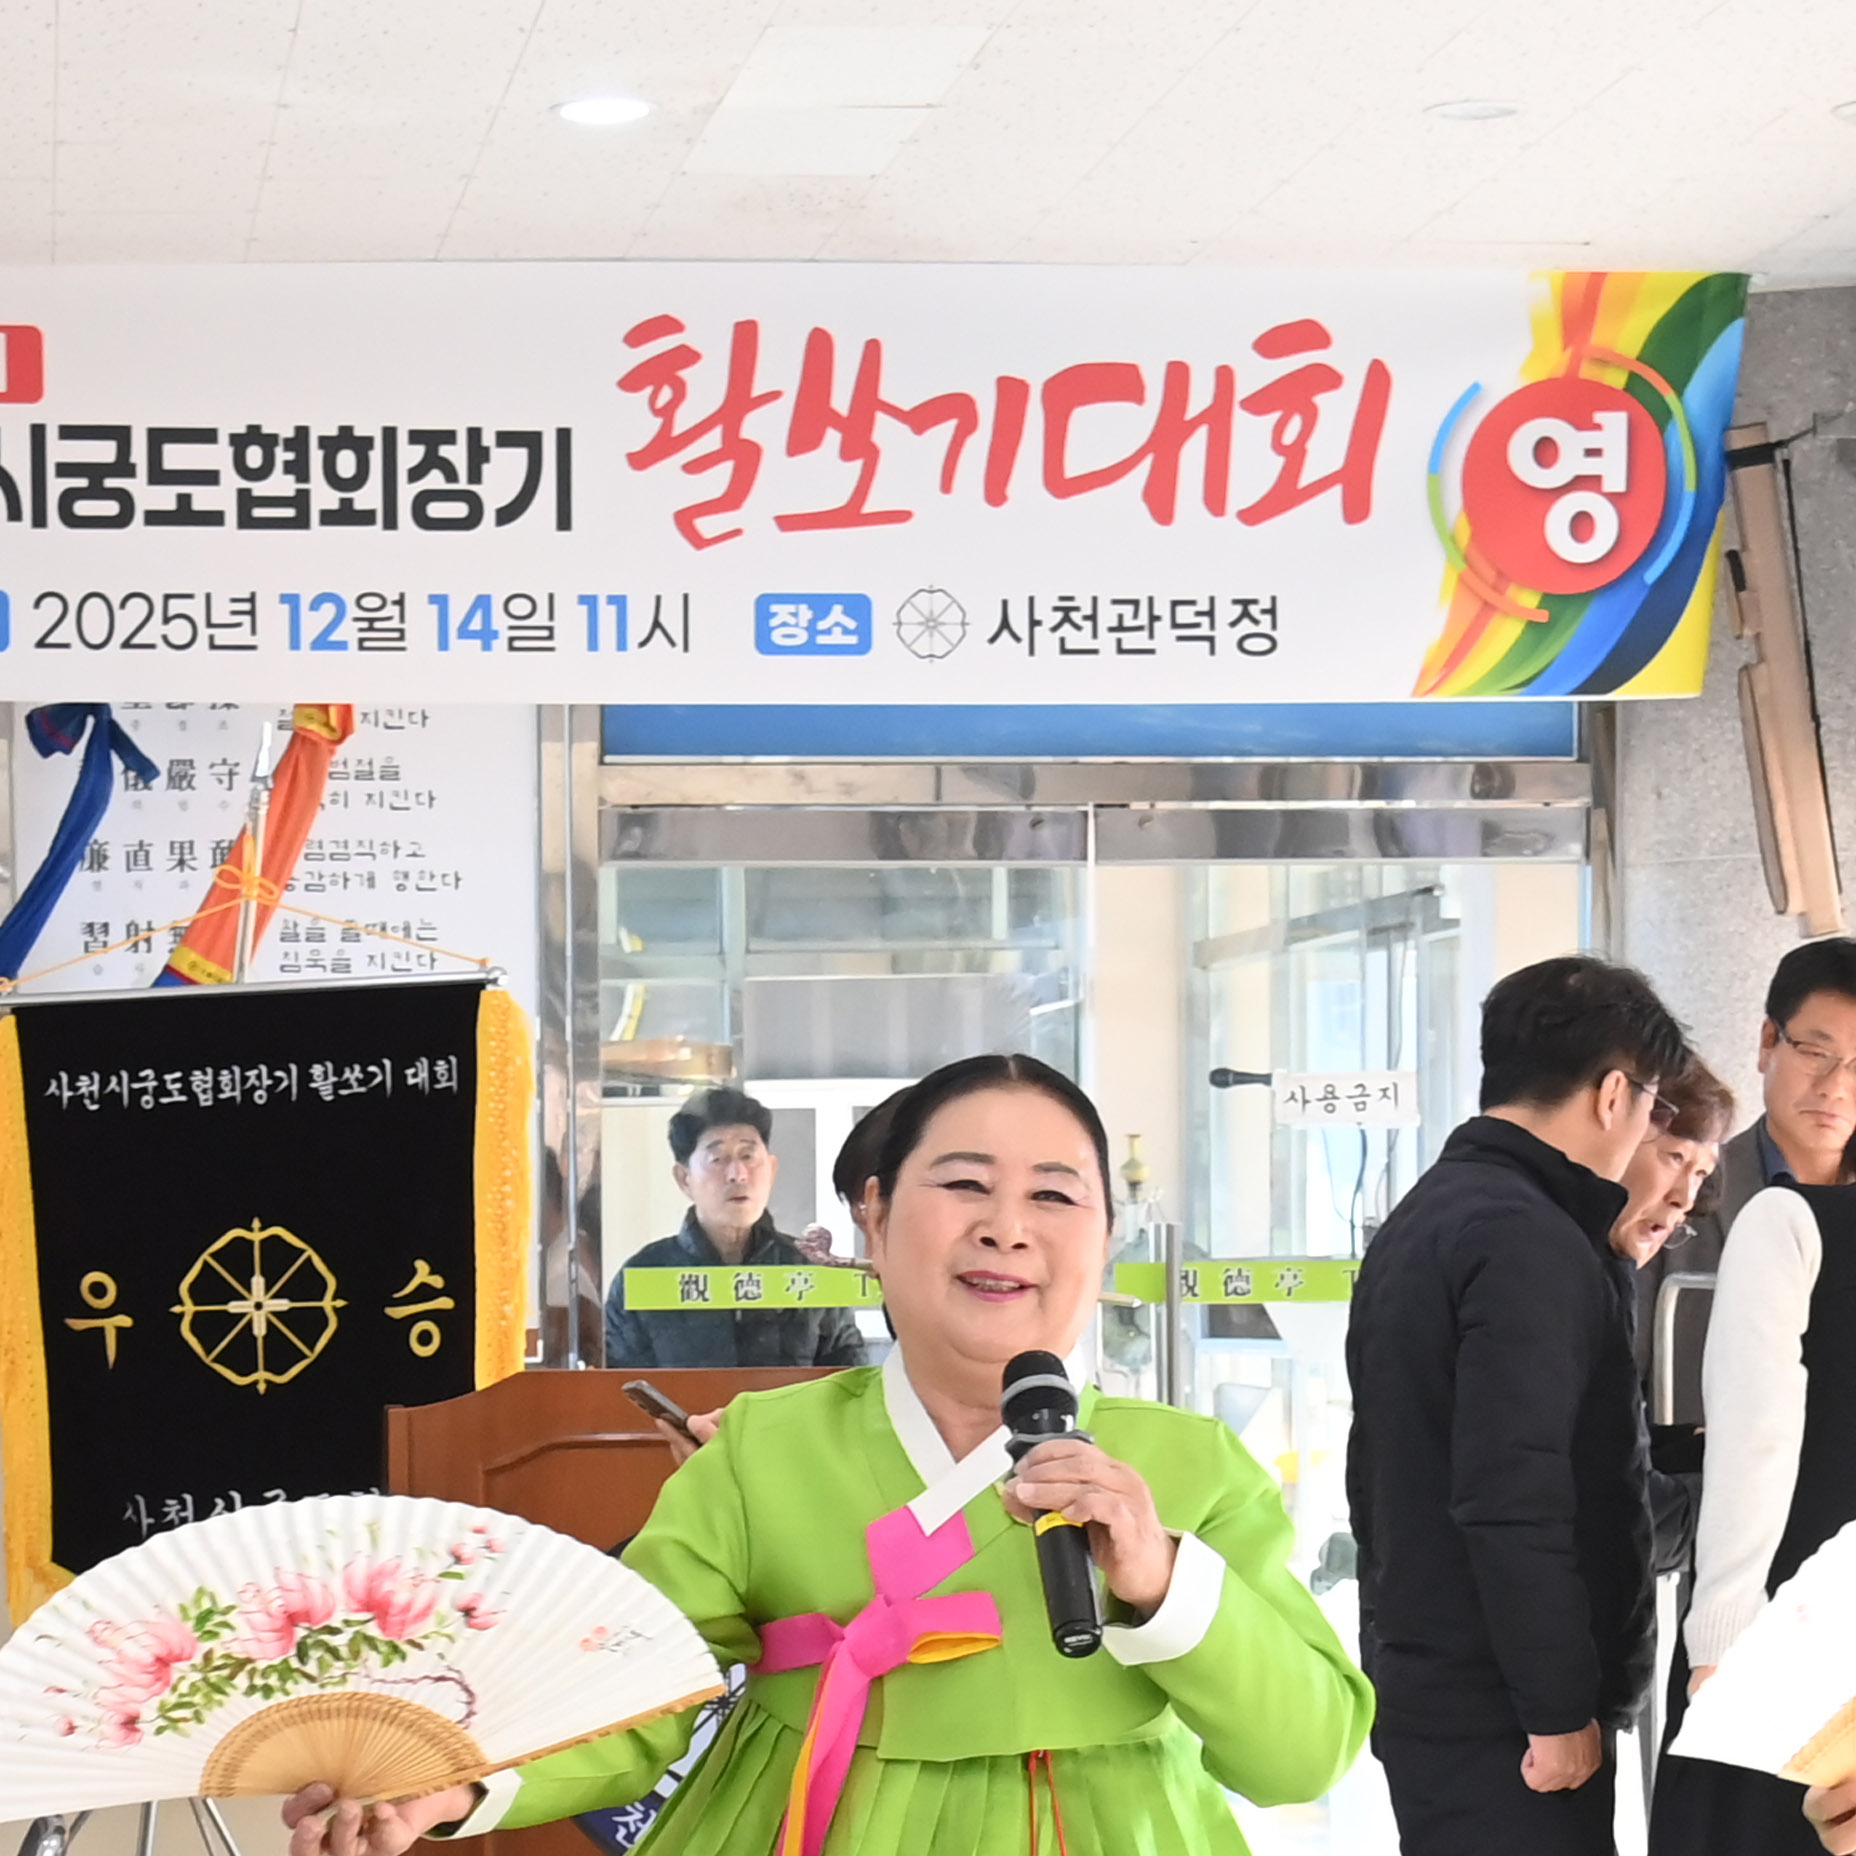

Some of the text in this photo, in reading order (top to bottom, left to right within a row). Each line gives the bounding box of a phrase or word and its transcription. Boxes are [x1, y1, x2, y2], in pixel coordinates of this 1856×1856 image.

[1505, 411, 1631, 566] 영
[32, 590, 261, 654] 2025년
[278, 591, 409, 653] 12월
[427, 592, 560, 653] 14일
[578, 592, 691, 655] 11시
[768, 594, 1280, 658] 장소 사천관덕정
[359, 707, 430, 731] 지킨다
[120, 756, 242, 793] 儀嚴守
[328, 755, 402, 783] 범절을
[364, 789, 438, 812] 지킨다
[366, 950, 438, 973] 지킨다
[45, 1054, 460, 1112] 사천시궁도협회장기 활쏘기 대회
[1282, 1081, 1400, 1115] 사용금지
[64, 1258, 456, 1370] 우 승
